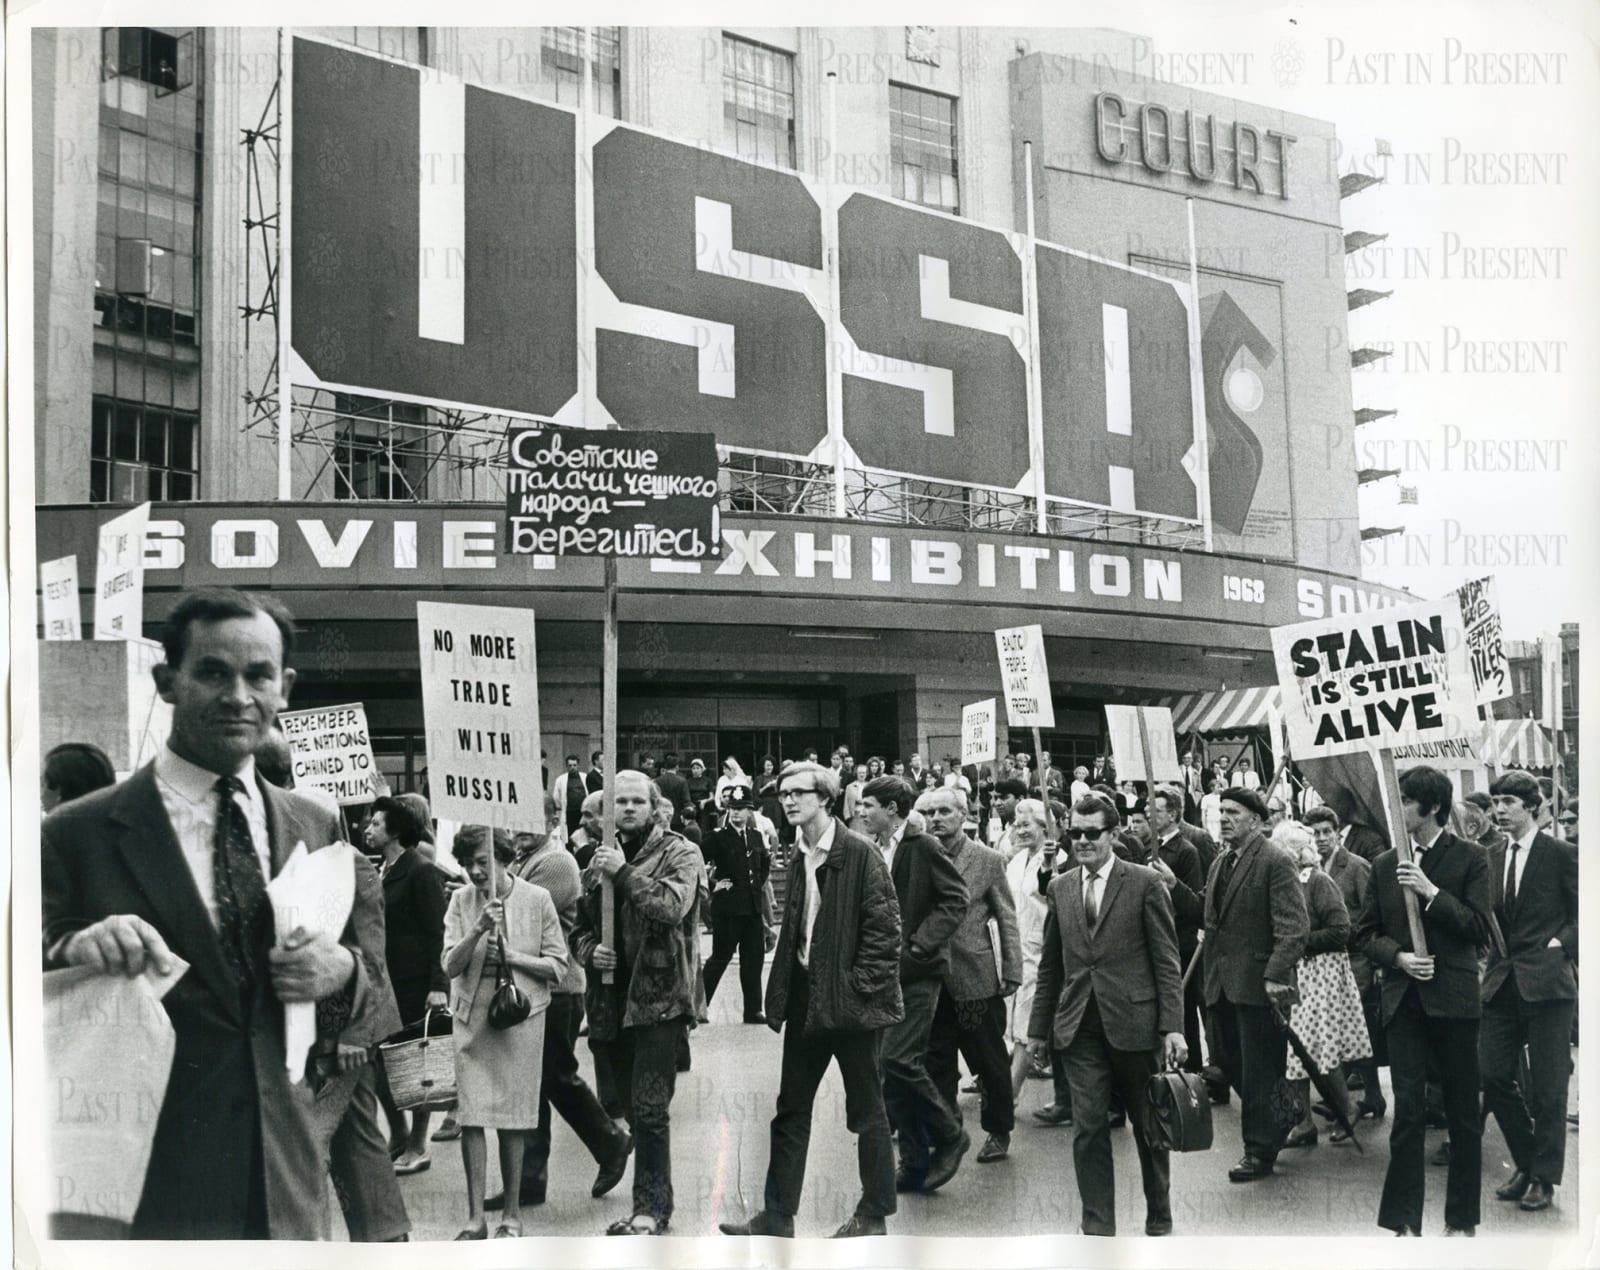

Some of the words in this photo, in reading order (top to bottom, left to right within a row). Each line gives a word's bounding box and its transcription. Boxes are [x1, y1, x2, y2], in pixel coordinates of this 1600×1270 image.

[1095, 90, 1298, 200] COURT
[291, 35, 1195, 520] USSR
[511, 431, 658, 470] Советские
[624, 474, 717, 499] чешкого
[520, 494, 610, 524] народа
[510, 503, 721, 557] Берегитесь!
[143, 519, 556, 570] SOVIE
[650, 529, 1182, 602] XHIBITION
[1223, 574, 1266, 604] 1968
[433, 629, 453, 653] NO
[470, 634, 516, 660] MORE
[1290, 614, 1446, 678] STALIN
[450, 679, 512, 707] TRADE
[1008, 676, 1029, 694] WANT
[1311, 680, 1341, 705] IS
[1349, 662, 1433, 697] STILL
[284, 709, 358, 734] REMEMBER
[1313, 691, 1443, 746] ALIVE
[289, 738, 311, 753] THE
[313, 730, 368, 751] NATIONS
[458, 728, 512, 756] WITH
[294, 756, 344, 778] CHAINED
[349, 753, 370, 770] TO
[310, 778, 369, 798] EMLIN
[446, 774, 518, 804] RUSSIA
